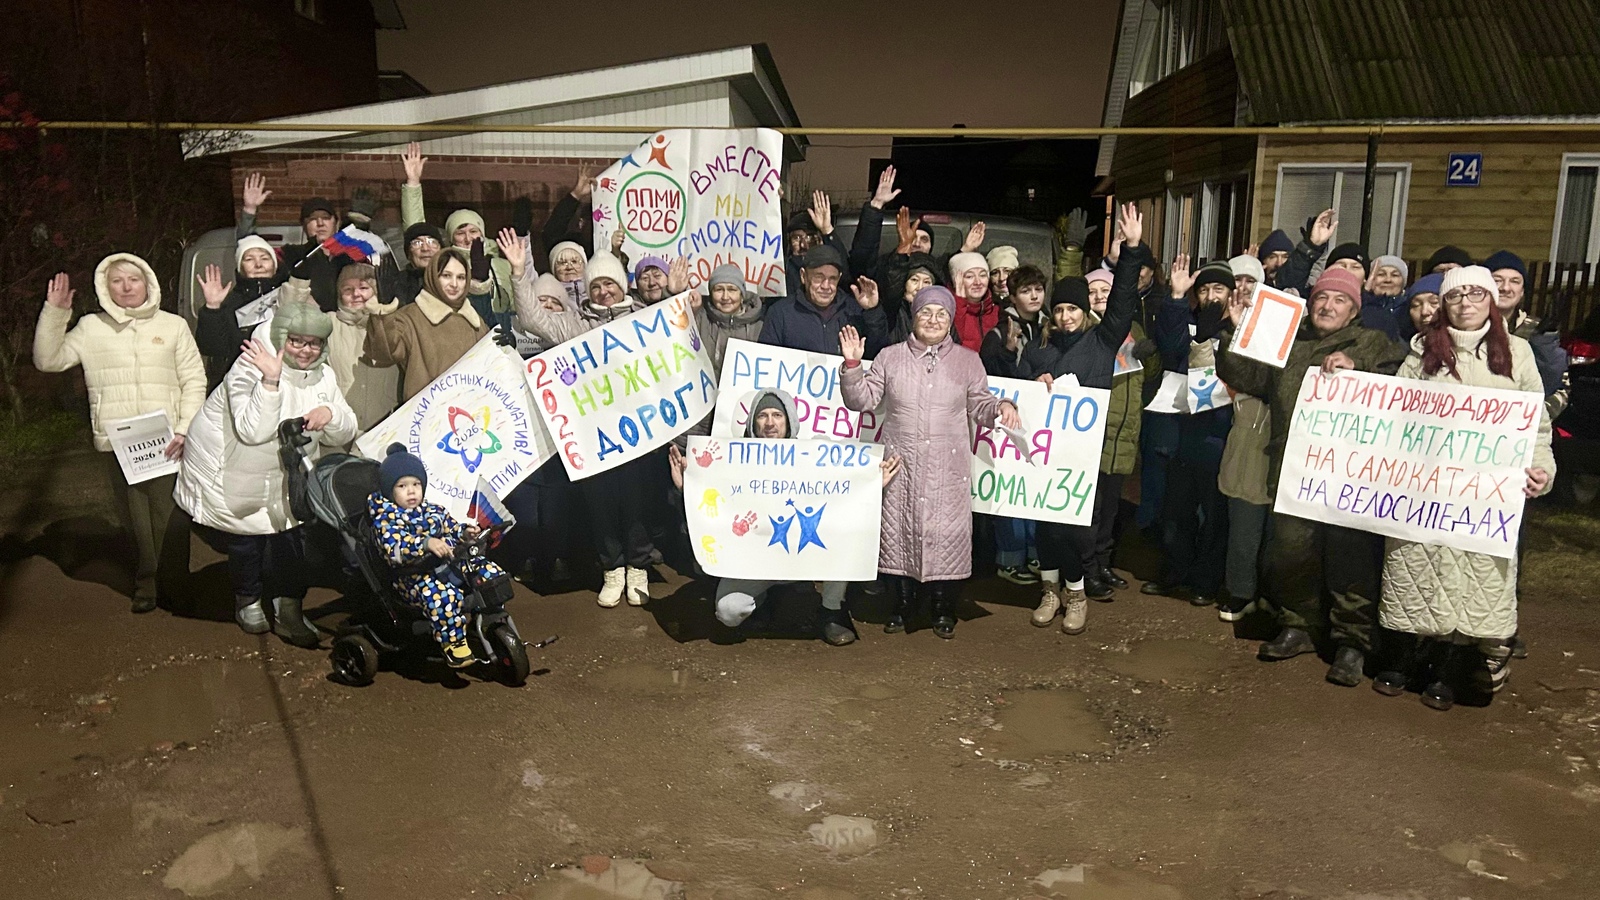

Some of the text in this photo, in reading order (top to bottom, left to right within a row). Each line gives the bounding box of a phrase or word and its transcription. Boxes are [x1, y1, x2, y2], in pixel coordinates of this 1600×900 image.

[690, 145, 781, 203] ВМЕСТЕ
[1450, 158, 1478, 180] 24
[626, 188, 680, 209] ППМИ
[715, 194, 751, 217] МЫ
[627, 209, 677, 234] 2026
[678, 220, 782, 259] СМОЖЕМ
[571, 308, 672, 375] НАМ
[570, 342, 696, 417] НУЖНА
[733, 351, 868, 401] РЕМОН
[409, 397, 430, 466] ДЕРЖКИ
[430, 373, 483, 400] МЕСТНЫХ
[484, 379, 533, 456] ИНИЦИАТИВ!
[527, 358, 585, 470] 2026
[597, 369, 716, 461] ДОРОГА
[1045, 394, 1098, 432] ПО
[1304, 373, 1538, 431] ХОТИМ РОВНУЮ ДОРОГУ
[128, 437, 166, 453] ППМИ
[454, 425, 479, 447] 2026
[728, 442, 795, 467] ППМИ
[815, 444, 873, 467] 2026
[1295, 409, 1528, 468] МЕЧТАЕМ КАТАТЬСЯ
[132, 450, 156, 463] 2026
[1305, 444, 1509, 503] НА САМОКАТАХ
[749, 479, 851, 495] ФЕВРАЛЬСКАЯ
[971, 469, 1026, 507] ОМА
[1298, 477, 1515, 542] НА ВЕЛОСИПЕДАХ
